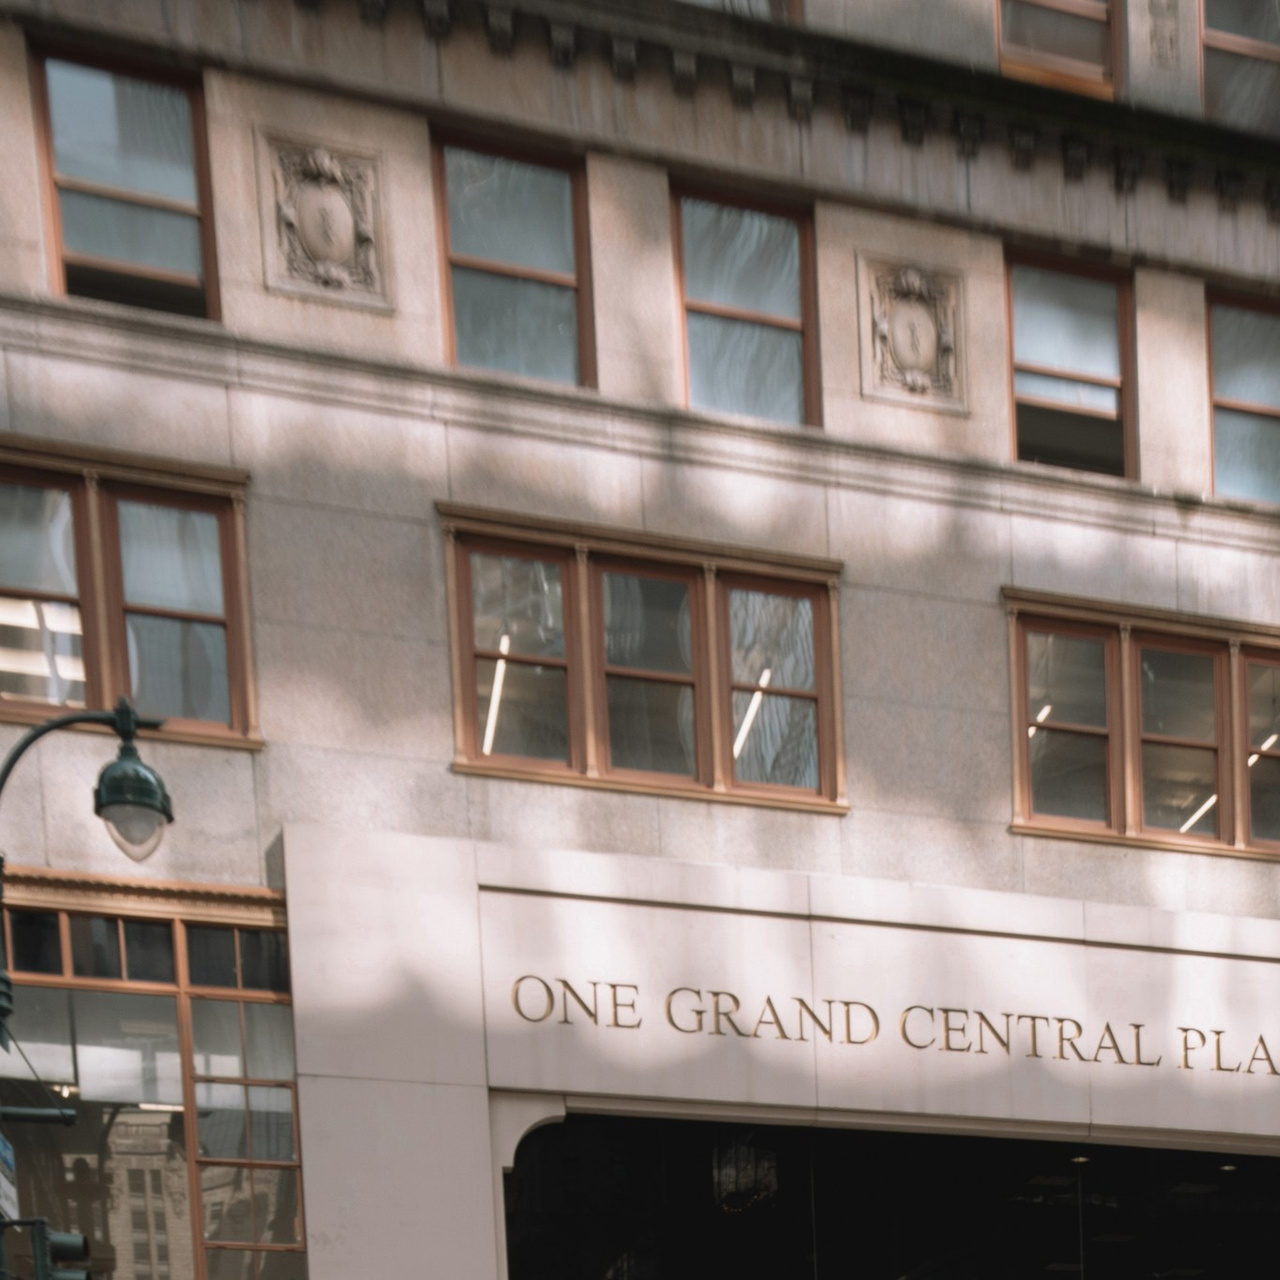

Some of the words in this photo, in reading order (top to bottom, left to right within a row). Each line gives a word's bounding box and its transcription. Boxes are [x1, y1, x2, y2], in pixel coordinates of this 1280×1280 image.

[510, 974, 643, 1029] ONE
[664, 986, 880, 1045] GRAND
[899, 1004, 1163, 1067] CENTRAL
